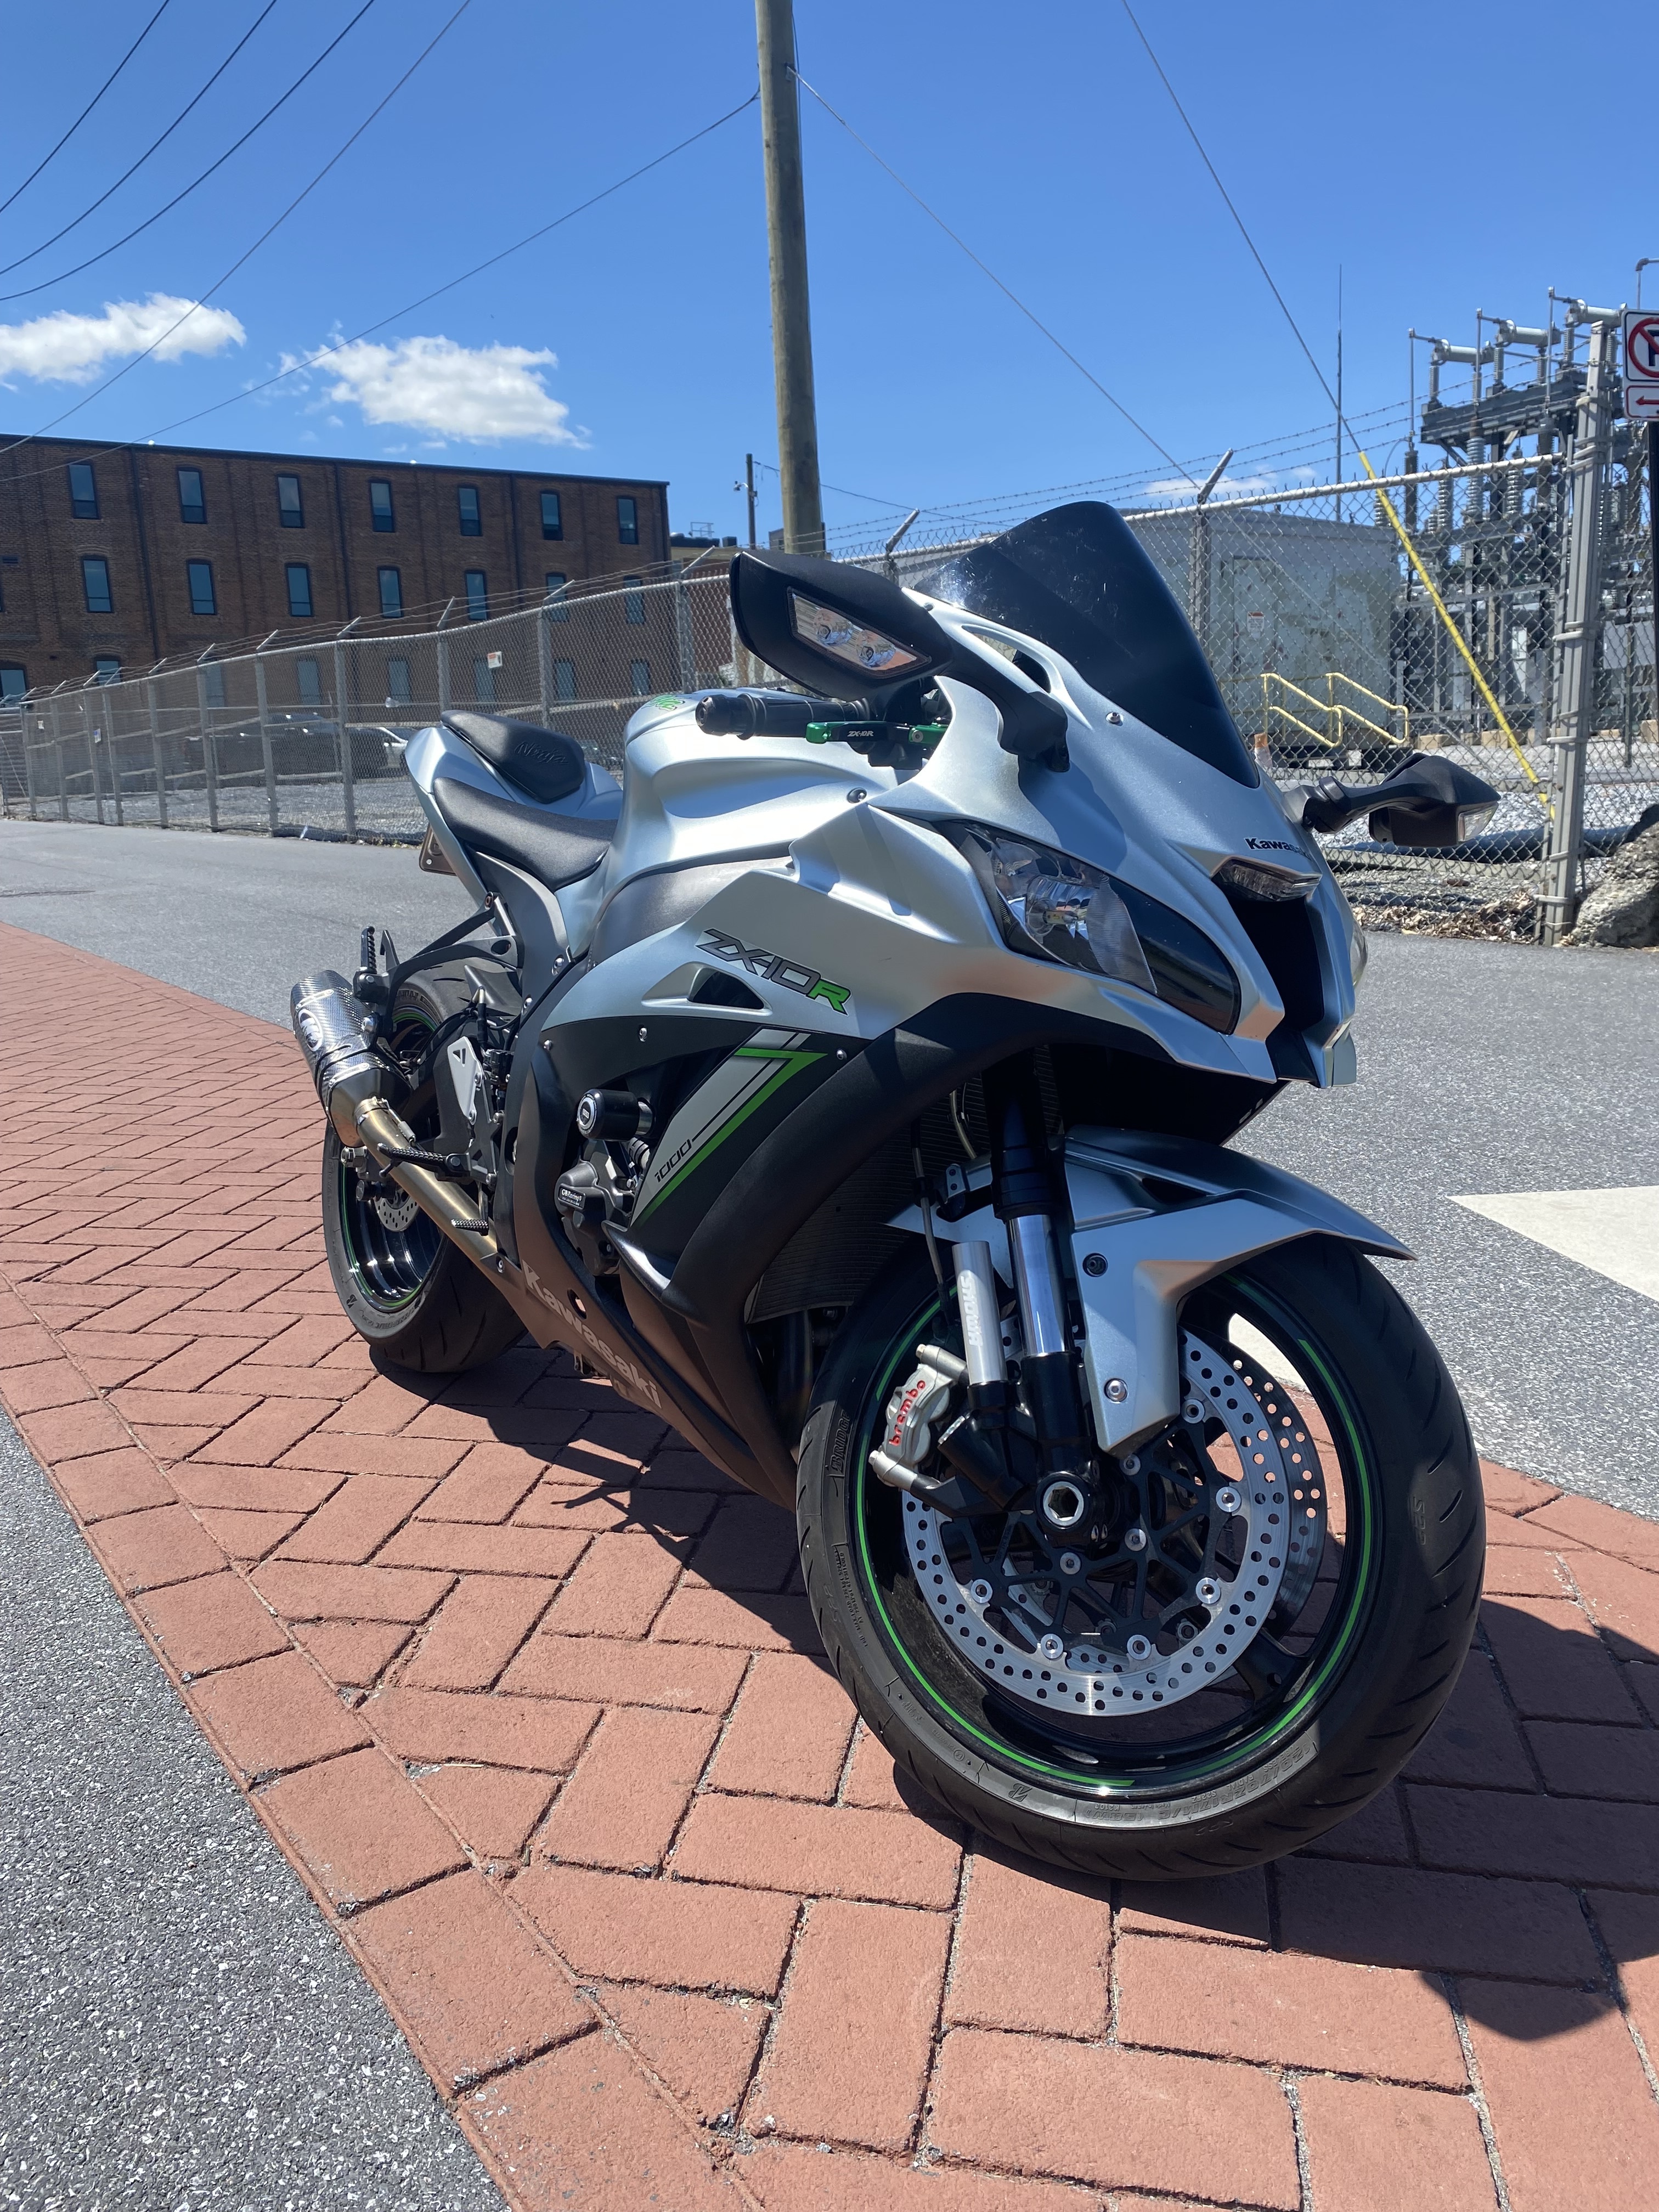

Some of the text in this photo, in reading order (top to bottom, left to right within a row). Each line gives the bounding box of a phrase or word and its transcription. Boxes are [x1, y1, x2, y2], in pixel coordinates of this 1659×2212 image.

[695, 928, 851, 1015] ZX-10R
[654, 1138, 692, 1183] 1000
[522, 1259, 662, 1409] Kawasaki
[961, 1276, 984, 1347] SHOWA
[888, 1380, 926, 1446] brembo
